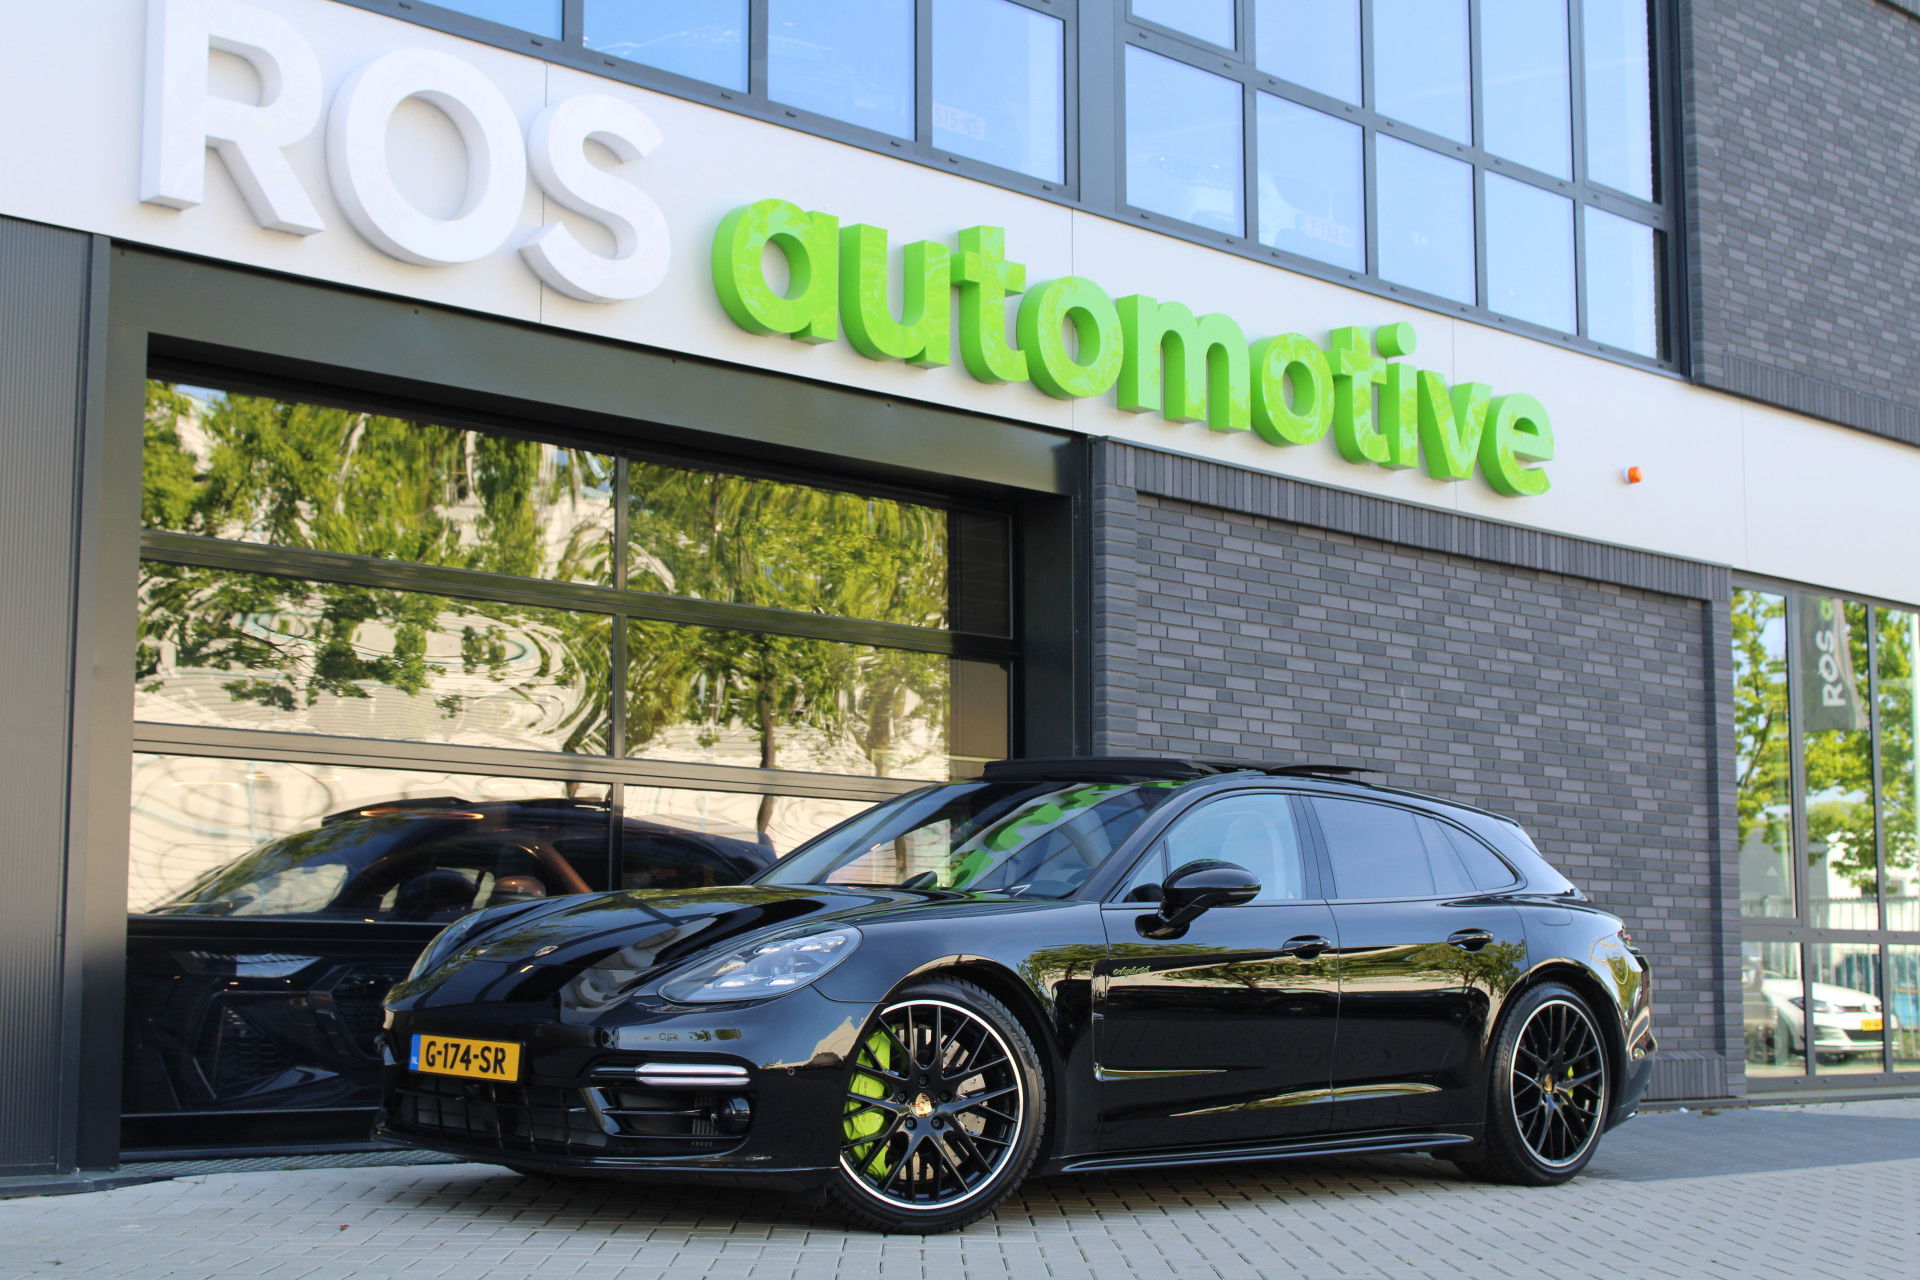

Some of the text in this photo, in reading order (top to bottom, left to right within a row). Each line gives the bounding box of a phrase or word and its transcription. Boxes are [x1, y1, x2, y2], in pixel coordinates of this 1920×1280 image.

[141, 0, 1554, 498] ROS automotive
[1815, 629, 1847, 707] ROS
[425, 1040, 506, 1075] G-174-SR
